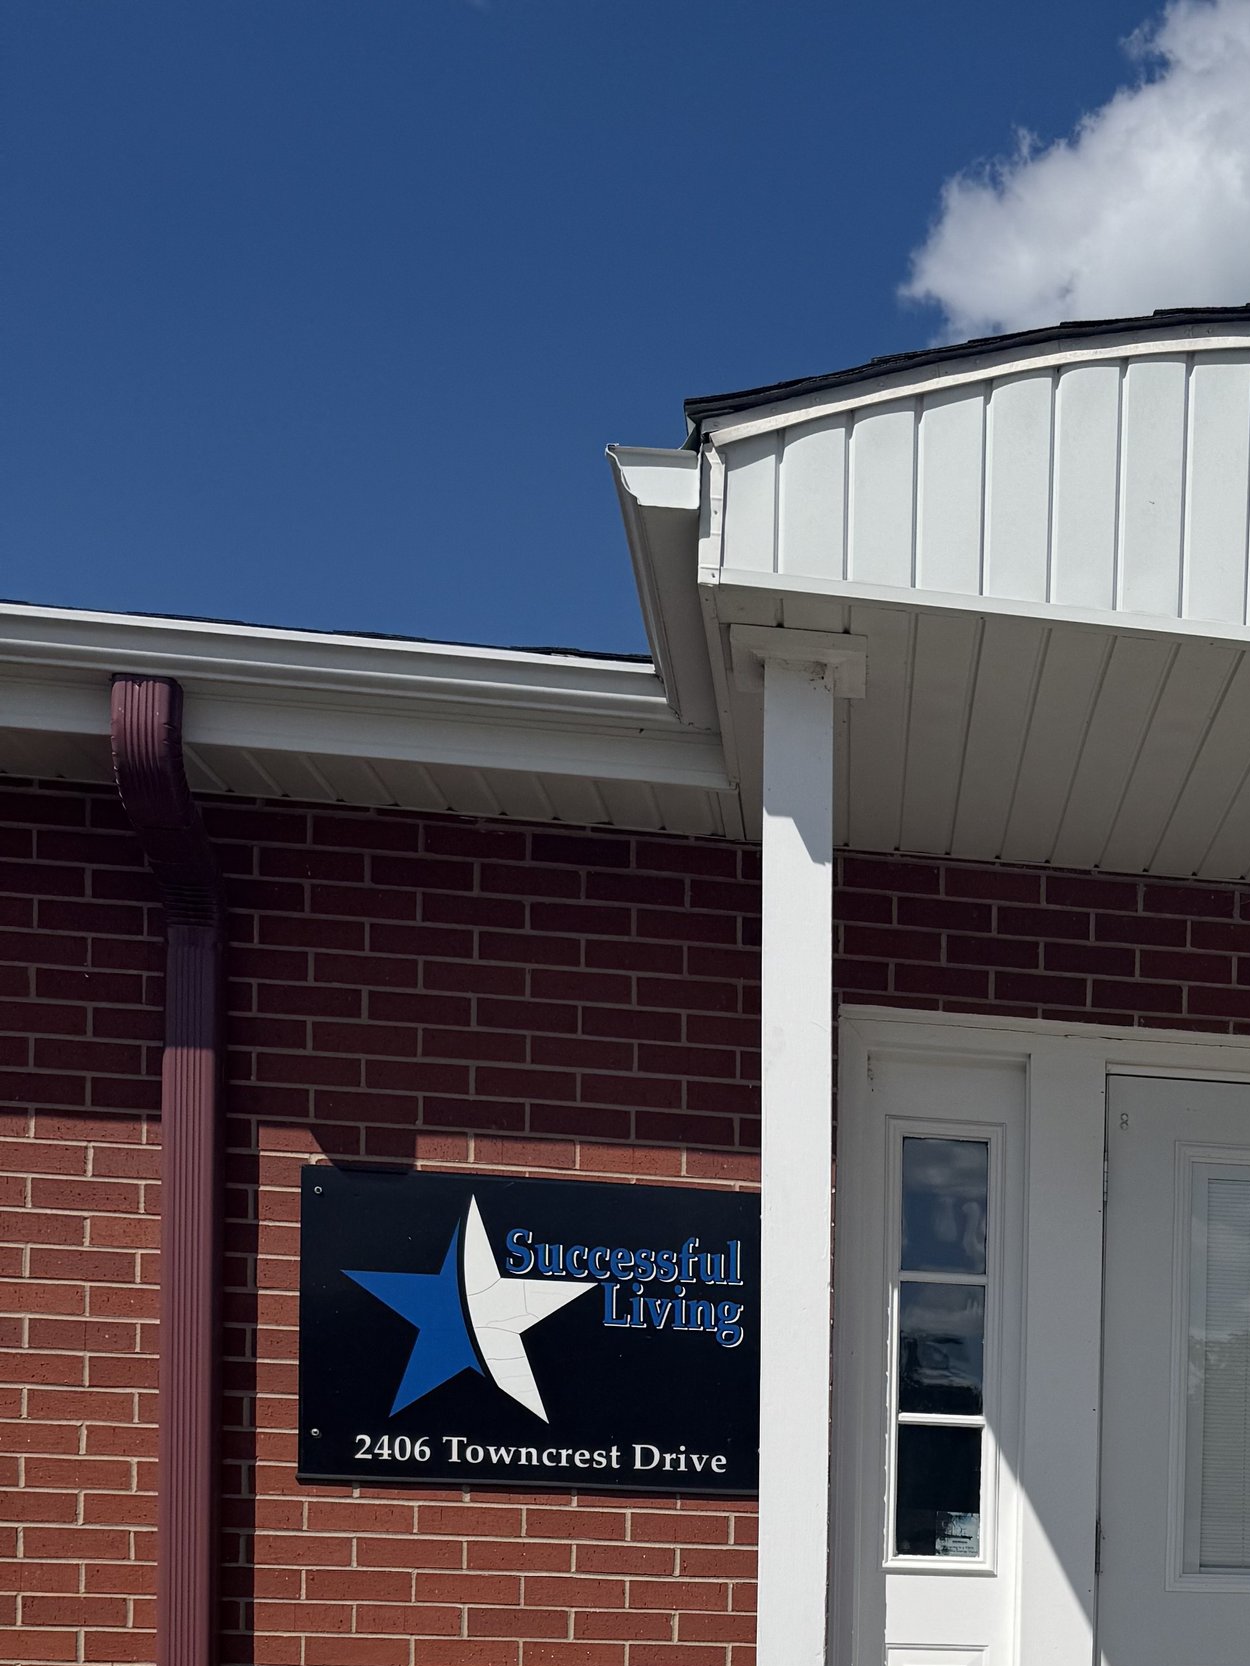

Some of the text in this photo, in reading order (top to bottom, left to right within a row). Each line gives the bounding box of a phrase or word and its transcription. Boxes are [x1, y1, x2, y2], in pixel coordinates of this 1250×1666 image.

[505, 1228, 744, 1286] Successful
[602, 1282, 744, 1348] Living
[354, 1434, 728, 1473] 2406 Towncrest Drive
